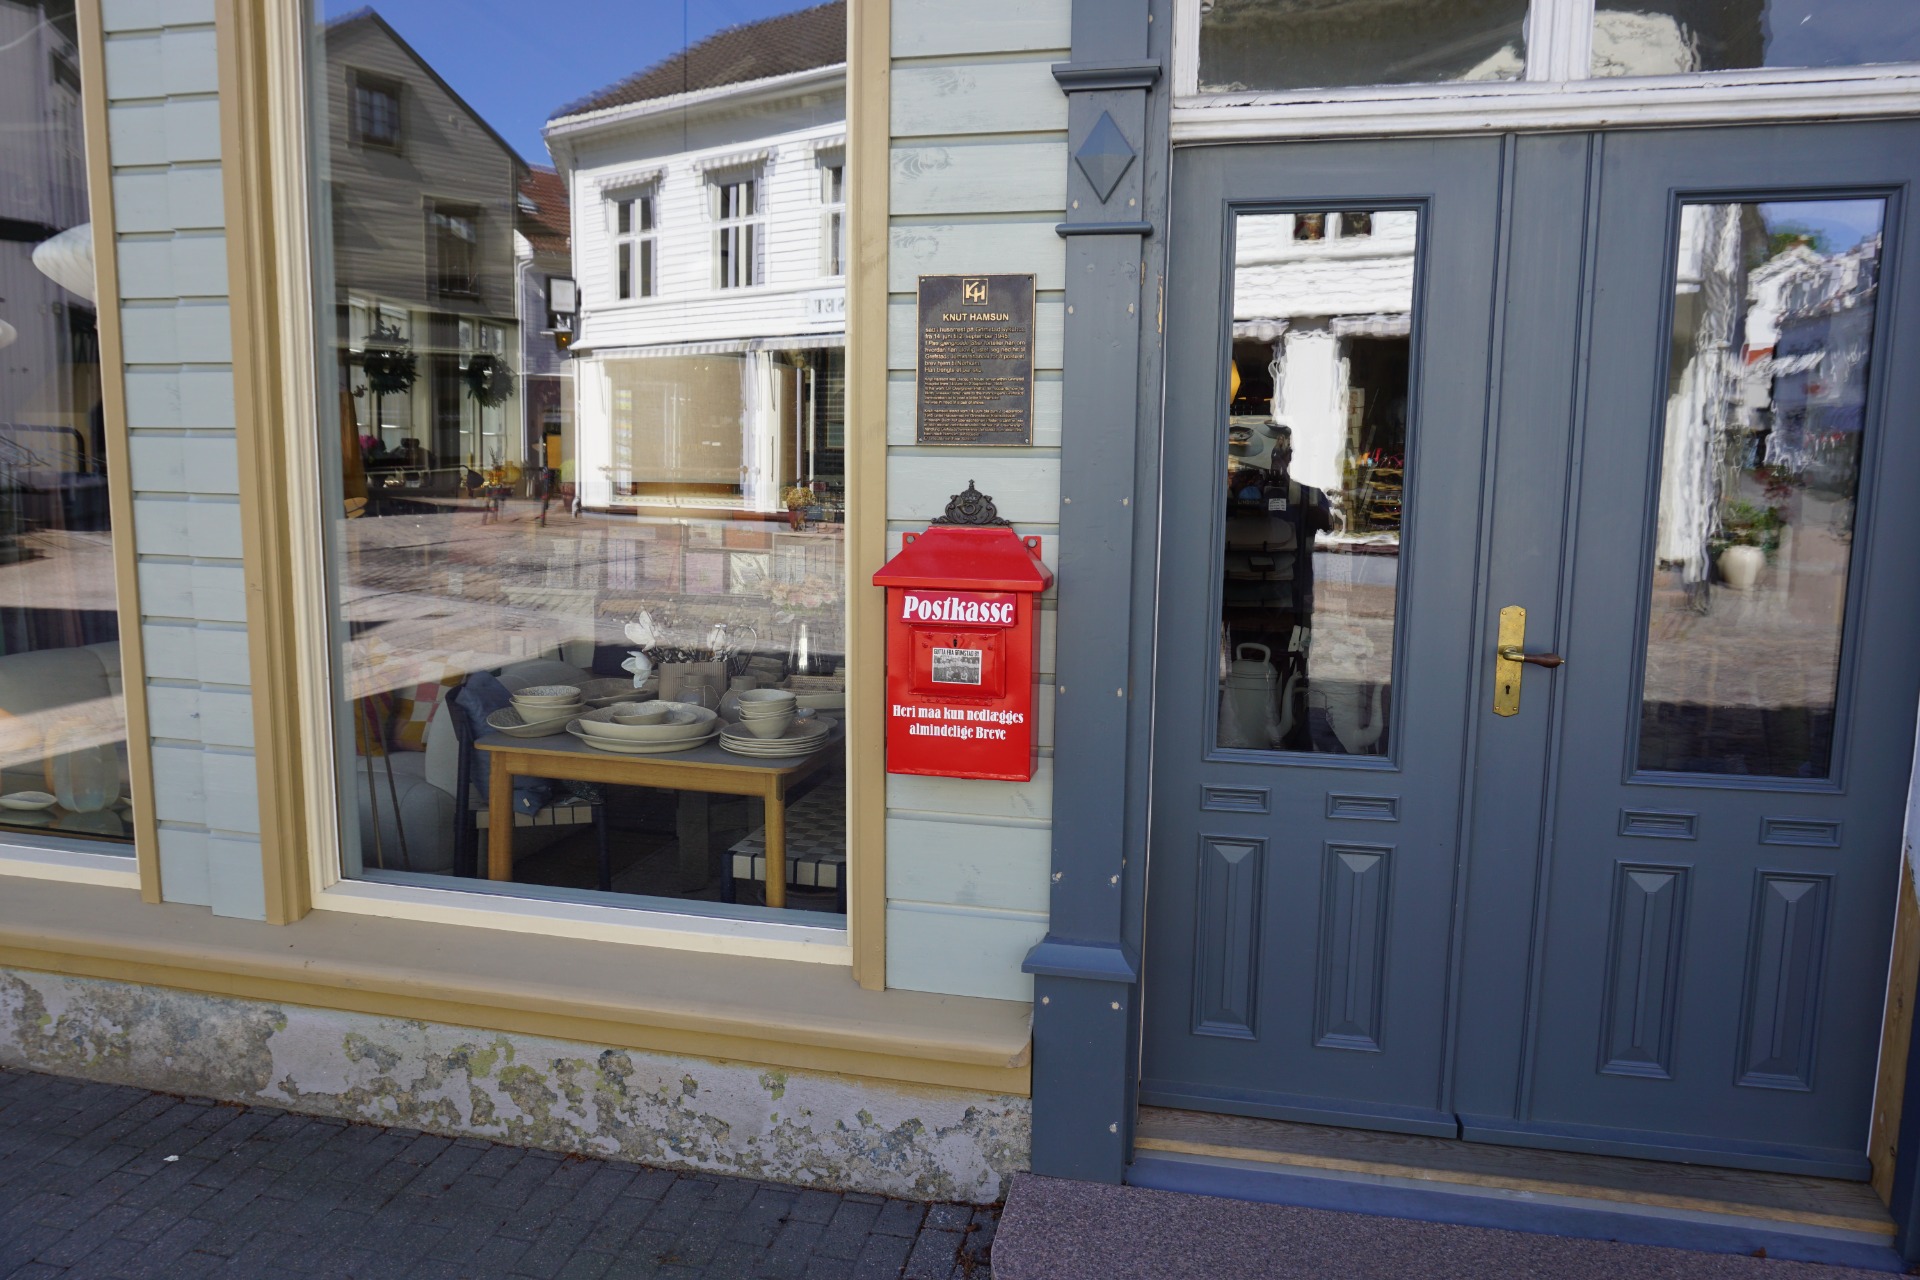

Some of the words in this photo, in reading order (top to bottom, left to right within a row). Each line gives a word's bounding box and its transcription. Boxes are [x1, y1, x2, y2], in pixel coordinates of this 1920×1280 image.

[943, 313, 968, 321] KNUT
[969, 313, 1009, 321] HAMSUN
[902, 596, 1014, 624] Postkasse
[893, 704, 916, 718] Heri
[918, 707, 941, 719] maa
[943, 707, 965, 720] kun
[967, 709, 1024, 726] nedlægges
[909, 723, 974, 740] almindelige
[976, 727, 1006, 740] Breve
